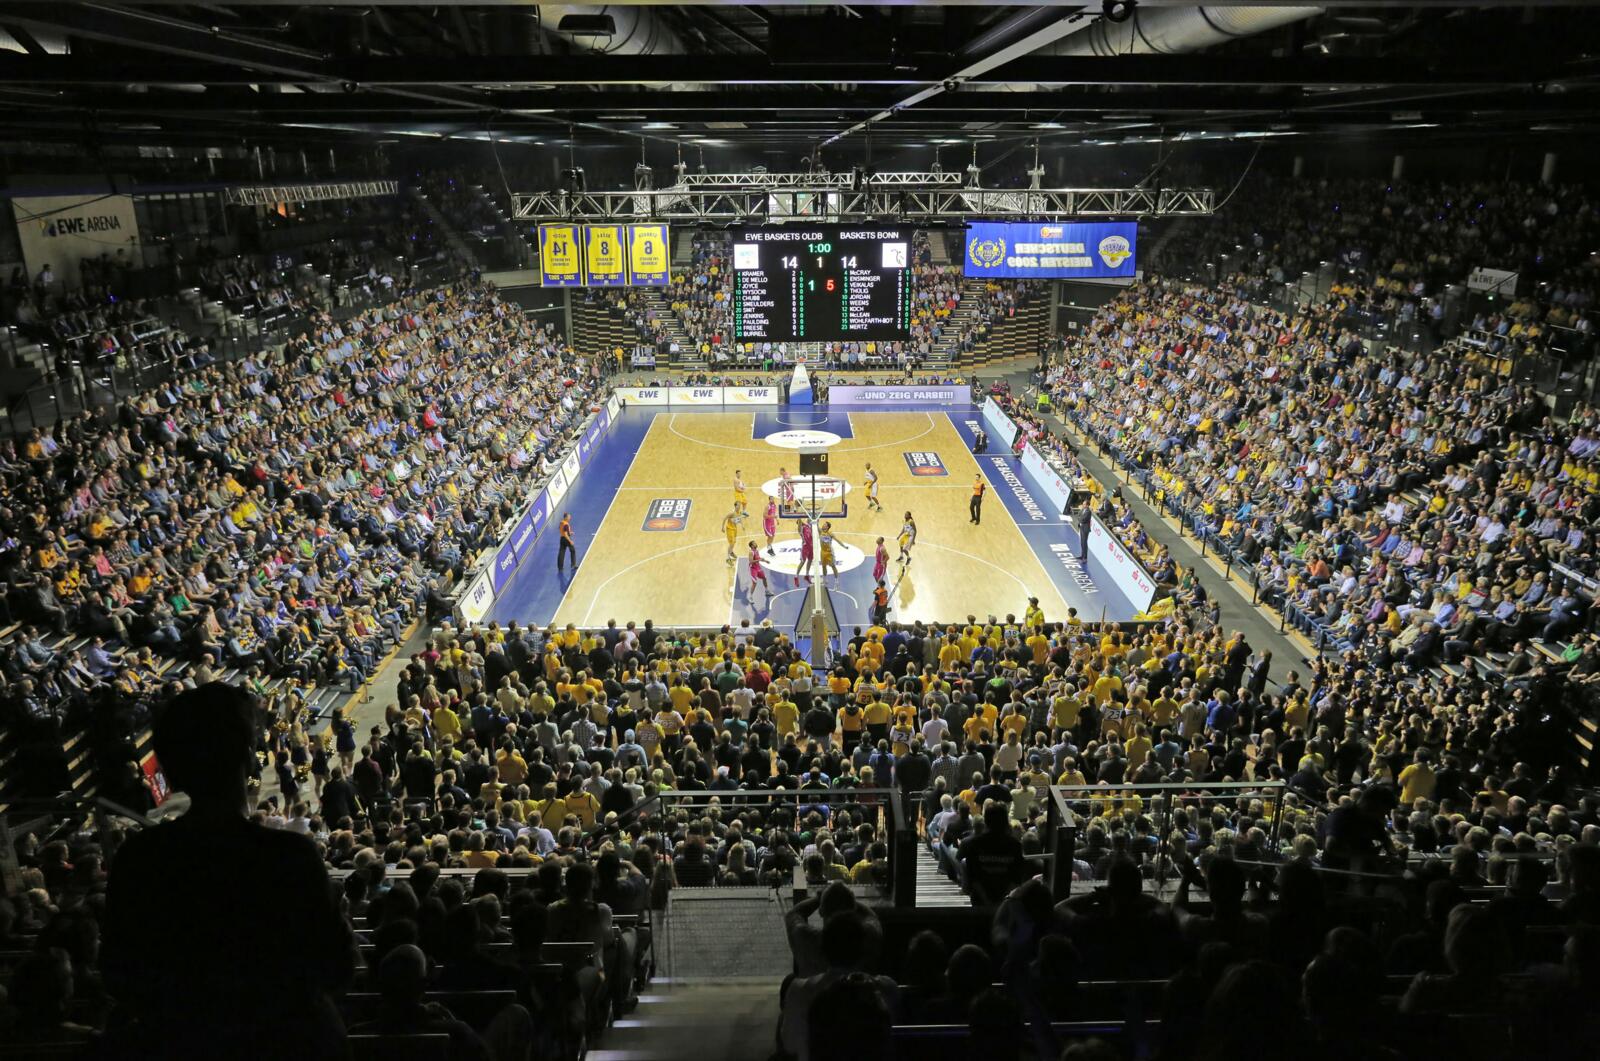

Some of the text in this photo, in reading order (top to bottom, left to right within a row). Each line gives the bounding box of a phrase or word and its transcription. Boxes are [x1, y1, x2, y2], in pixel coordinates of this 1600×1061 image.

[57, 216, 121, 234] EWE ARENA
[808, 243, 831, 253] 1:00
[781, 256, 798, 269] 14
[816, 256, 823, 268] 1
[841, 256, 857, 268] 14
[808, 280, 814, 291] 1
[826, 280, 834, 290] 5
[911, 453, 927, 466] BBL
[656, 500, 676, 518] BBL
[1012, 487, 1047, 520] OLDENBURG
[1114, 550, 1124, 563] LzO
[1056, 552, 1099, 594] EWE ARENA
[1138, 579, 1150, 593] LzO
[474, 582, 486, 604] EWE
[1108, 711, 1120, 719] 23
